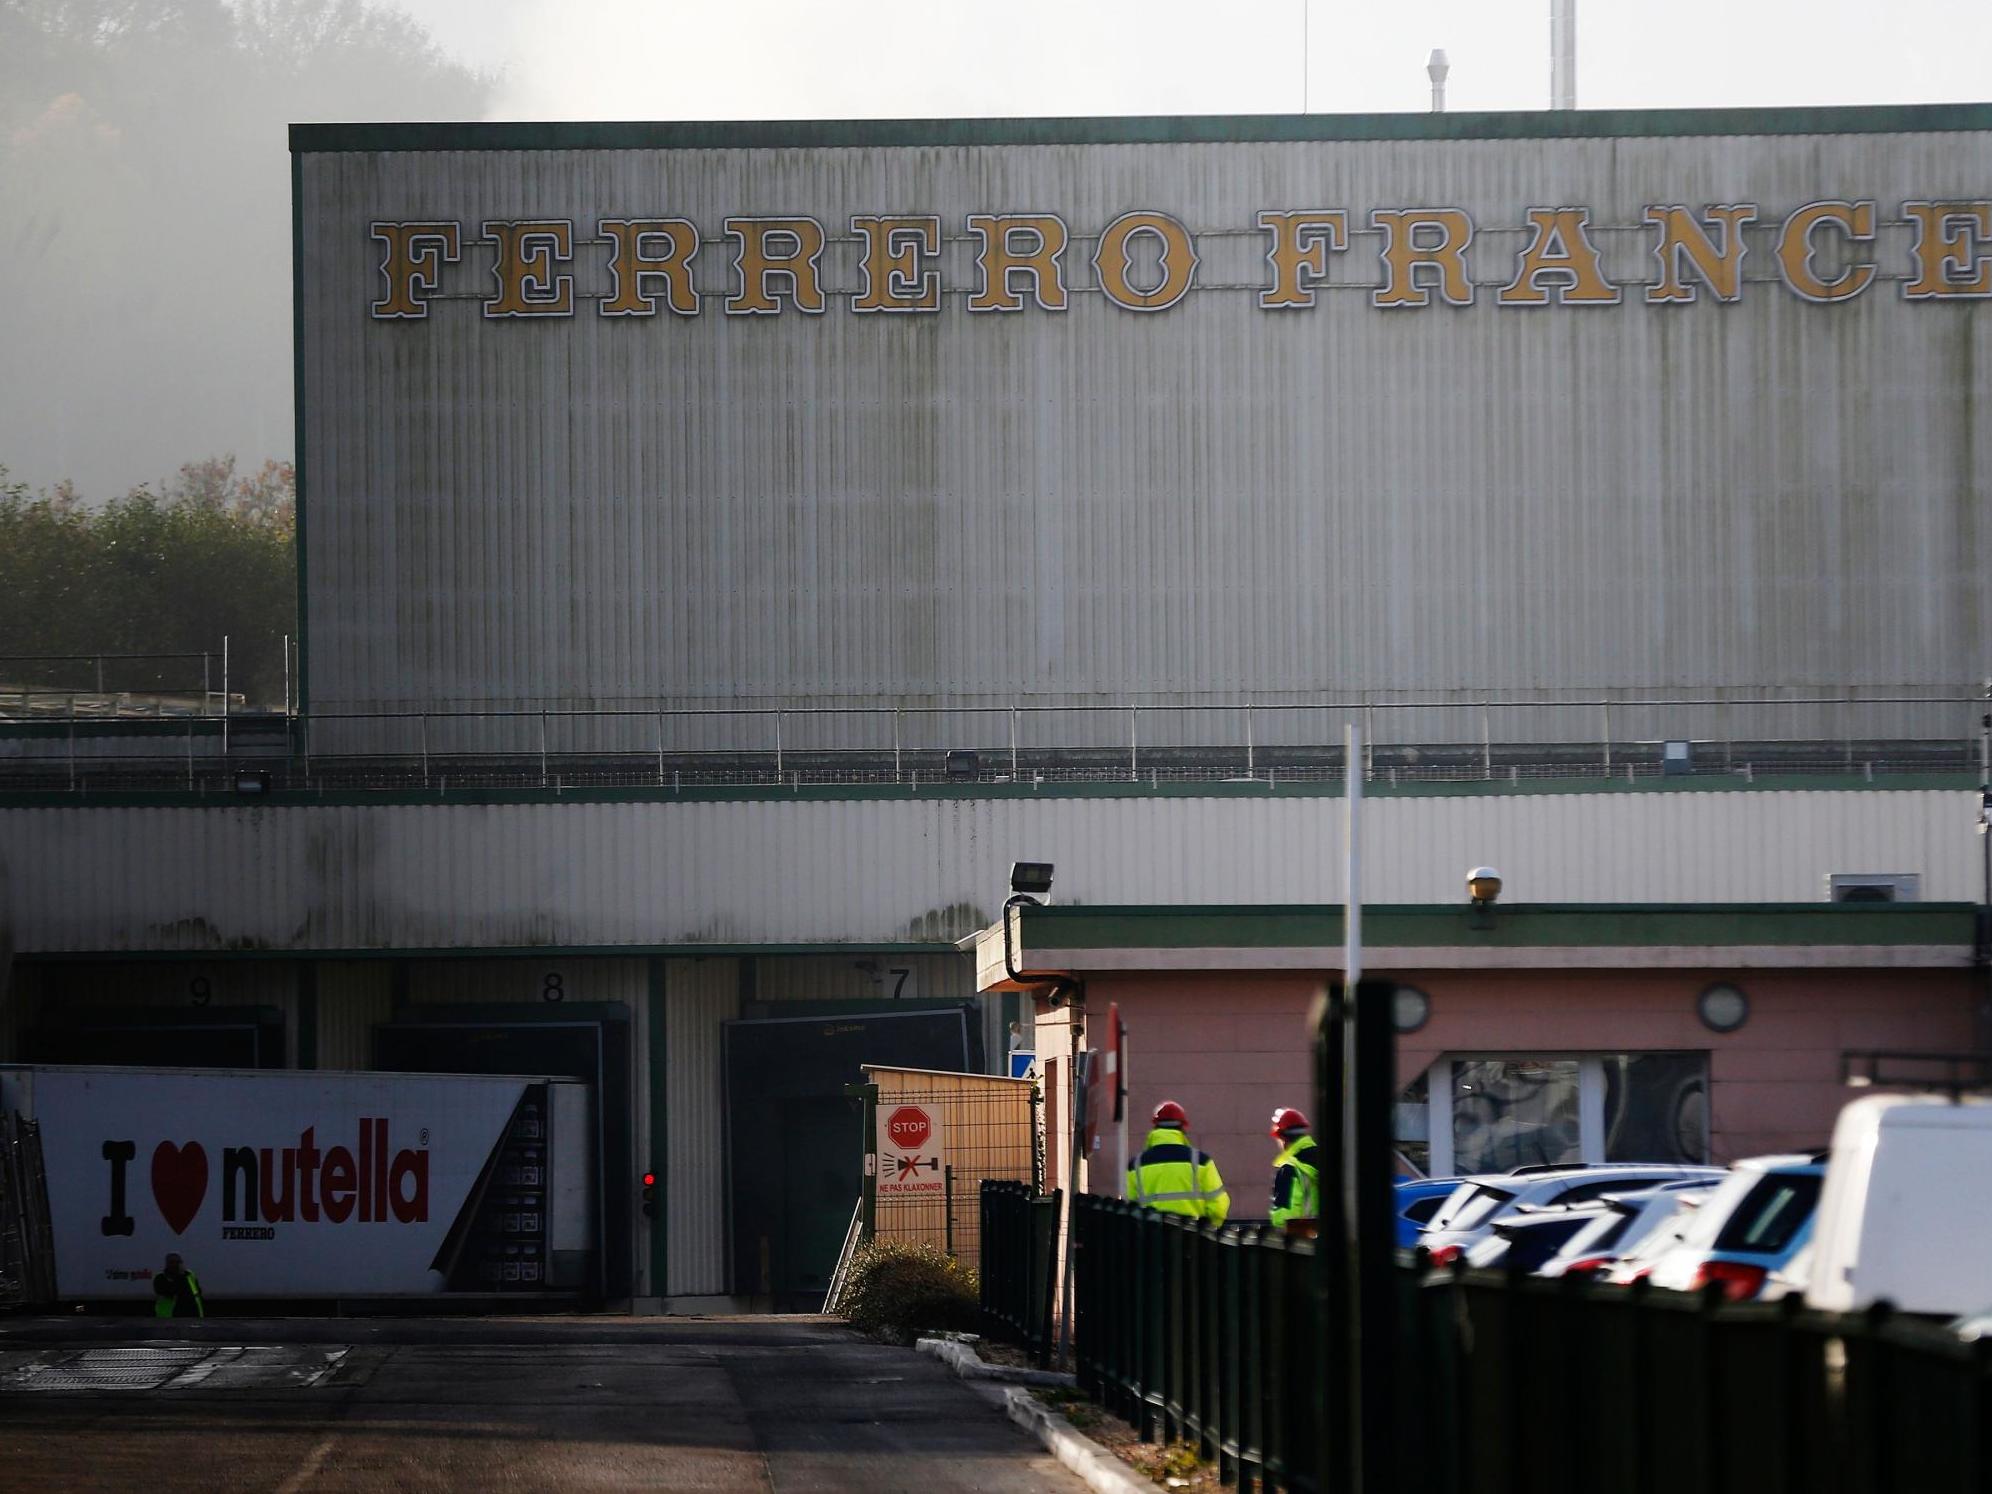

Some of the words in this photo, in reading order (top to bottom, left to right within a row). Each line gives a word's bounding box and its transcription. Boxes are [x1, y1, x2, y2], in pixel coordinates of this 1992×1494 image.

[370, 209, 1200, 321] FERRERO
[1256, 200, 1992, 310] FRANCE
[191, 976, 210, 1008] 9
[544, 973, 564, 1002] 8
[889, 969, 909, 999] 7
[893, 1122, 926, 1135] STOP
[101, 1141, 135, 1236] I
[223, 1118, 428, 1224] nutella
[880, 1185, 889, 1193] NE
[890, 1184, 902, 1192] PAS
[903, 1183, 942, 1192] KLAXONNER
[223, 1227, 275, 1240] FERRERO
